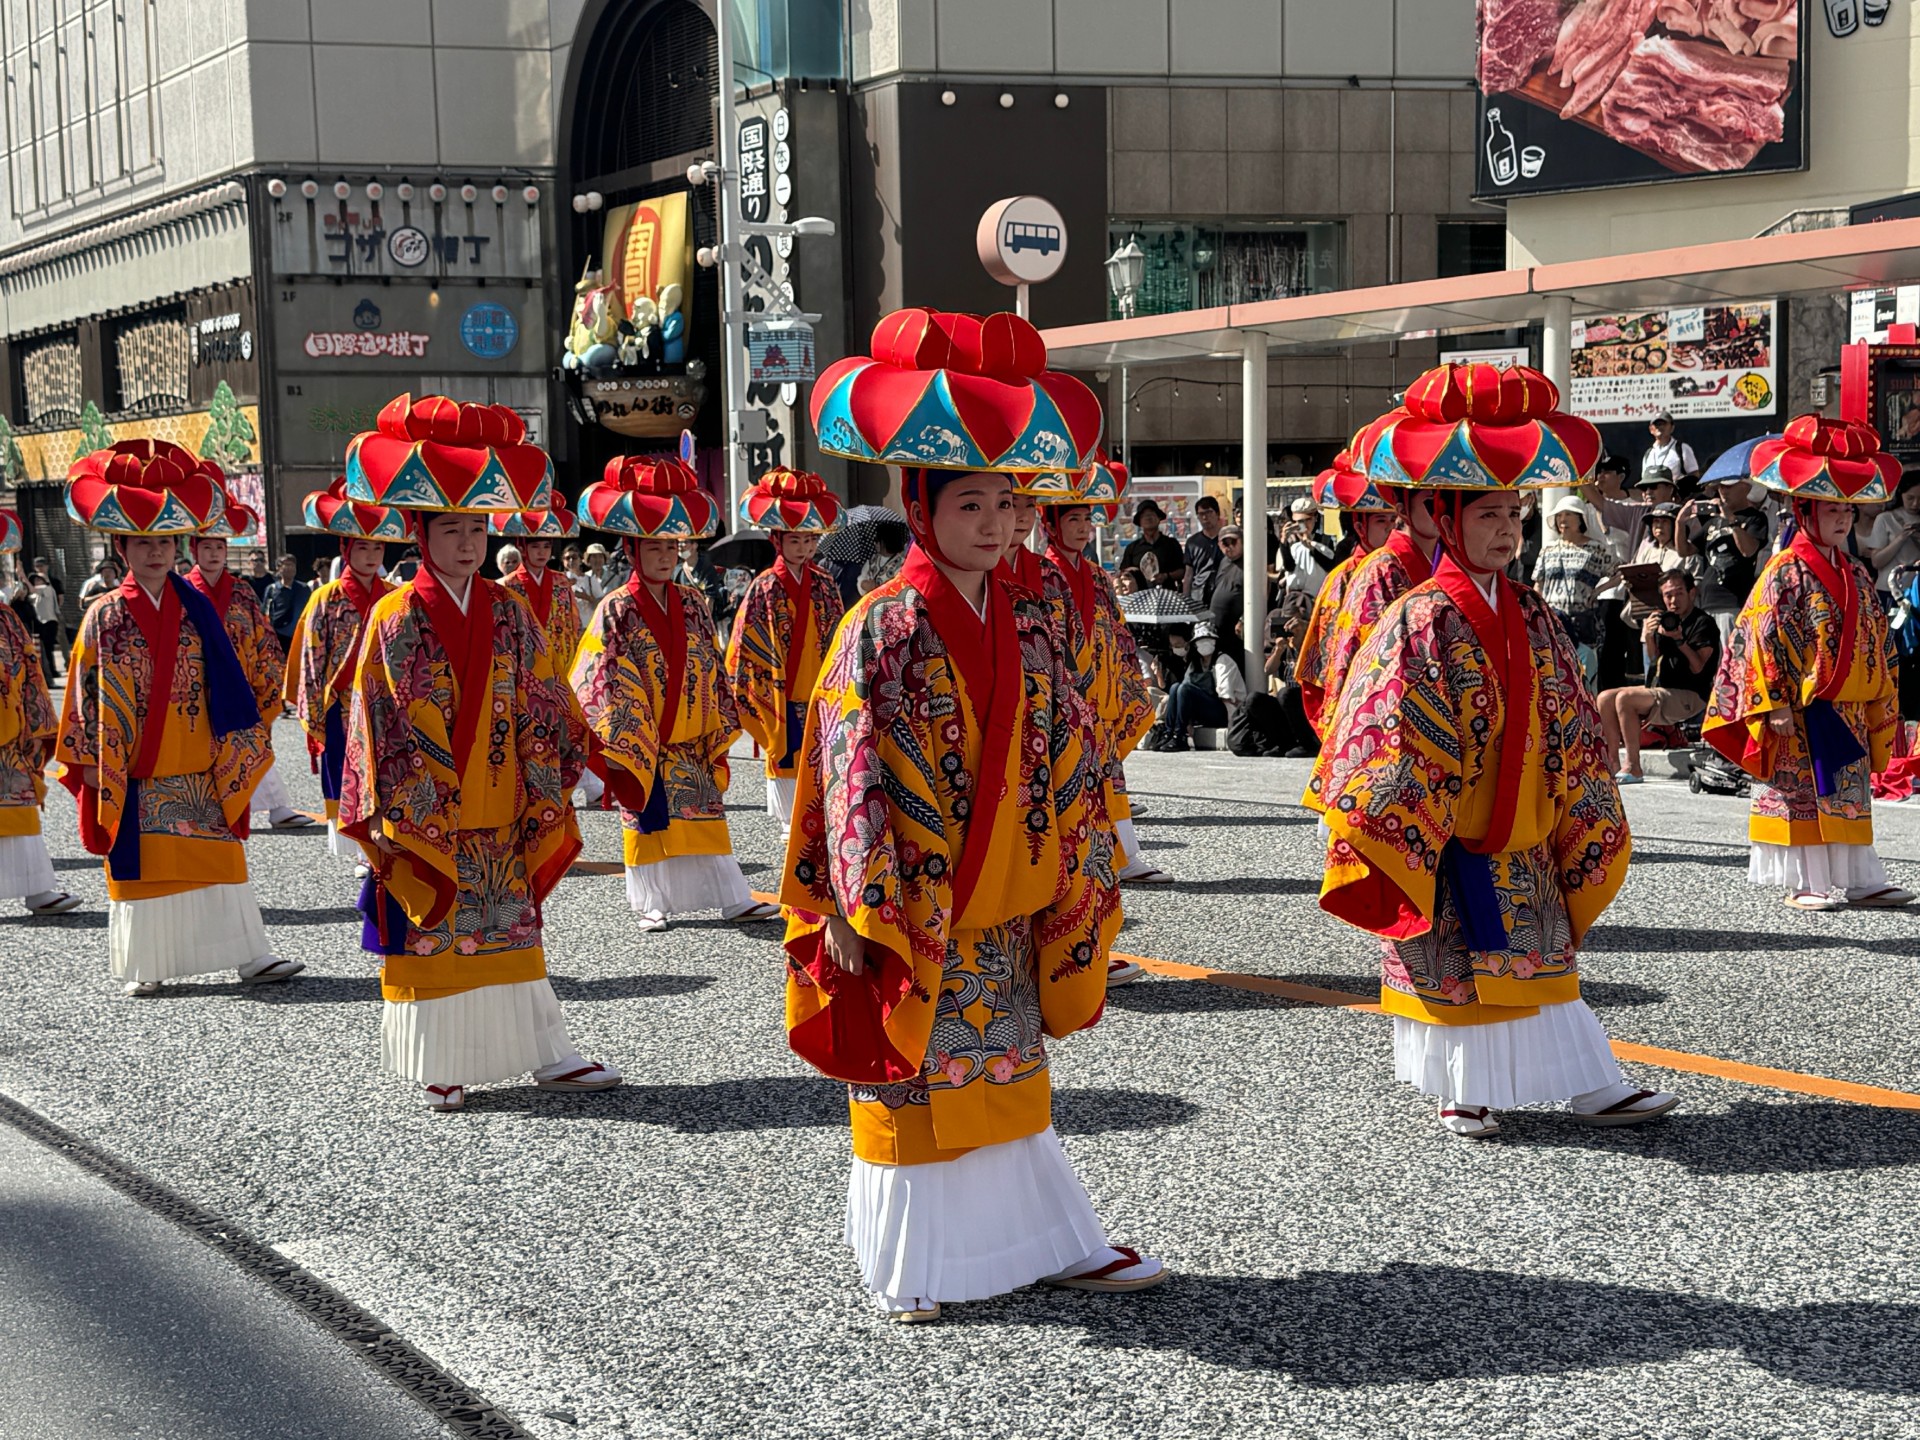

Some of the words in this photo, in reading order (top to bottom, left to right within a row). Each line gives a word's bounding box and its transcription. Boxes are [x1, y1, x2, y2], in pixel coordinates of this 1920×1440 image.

[741, 123, 766, 219] 国際通り
[278, 211, 293, 222] 2F
[282, 292, 296, 301] 1F
[305, 332, 429, 356] 国際通り横丁
[287, 386, 303, 396] B1
